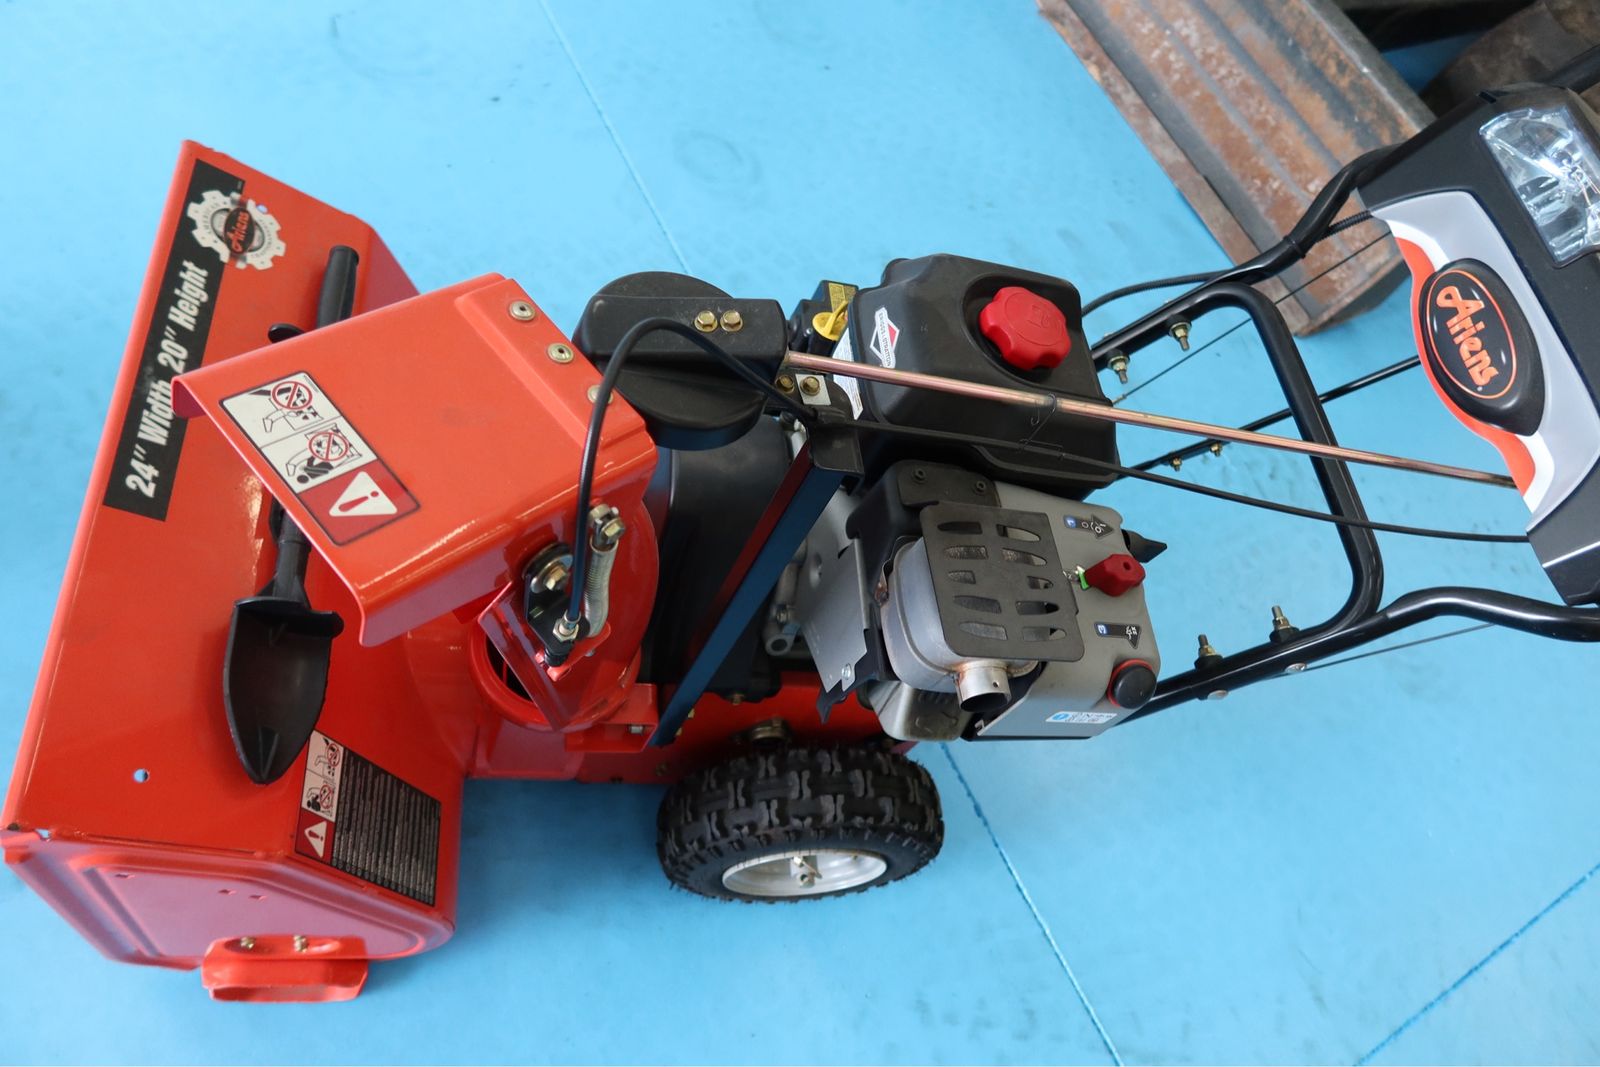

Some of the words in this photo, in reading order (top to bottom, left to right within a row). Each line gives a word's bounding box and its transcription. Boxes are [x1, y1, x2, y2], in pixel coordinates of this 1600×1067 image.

[226, 211, 249, 252] Ariens
[168, 260, 208, 332] Height
[157, 324, 188, 374] 20"
[1436, 285, 1499, 386] Ariens
[125, 443, 159, 498] 24"
